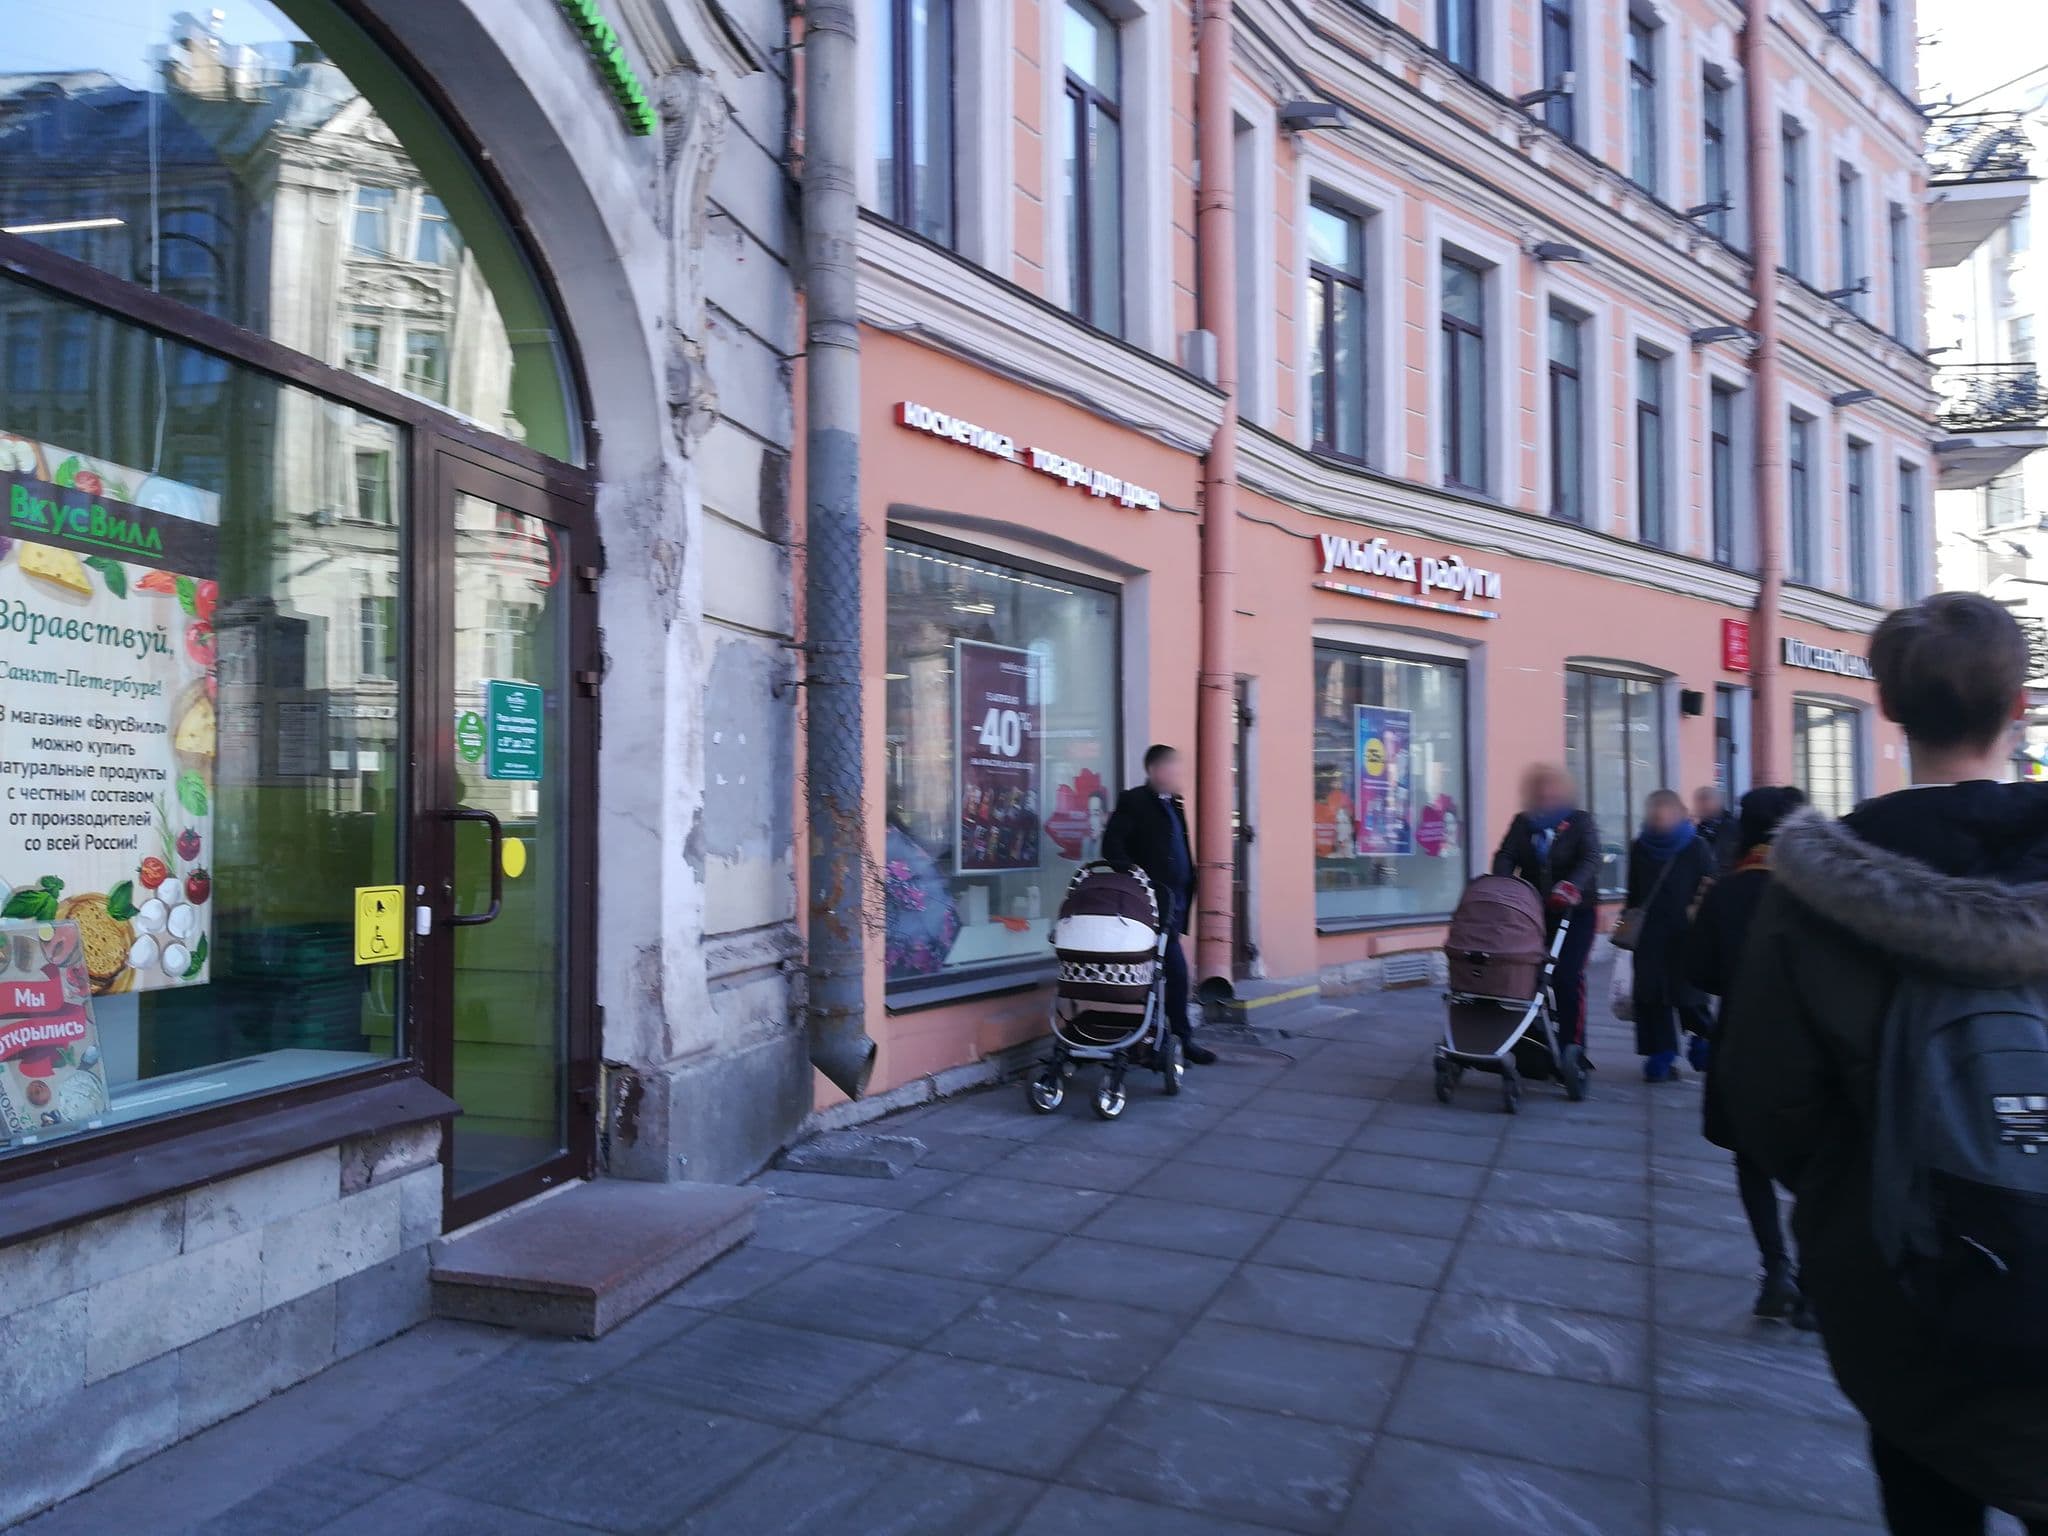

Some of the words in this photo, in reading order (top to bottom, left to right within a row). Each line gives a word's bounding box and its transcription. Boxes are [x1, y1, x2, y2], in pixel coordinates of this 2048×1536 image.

[10, 484, 163, 550] ВкусВилл
[1420, 555, 1501, 600] радуги
[11, 709, 82, 728] магазине
[86, 713, 167, 734] «ВкусВилл»
[32, 737, 83, 752] можно
[88, 741, 136, 757] купить
[99, 765, 166, 782] продукты
[7, 787, 15, 800] с
[20, 786, 86, 801] честным
[91, 788, 154, 803] составом
[9, 812, 27, 825] от
[32, 811, 151, 830] производителей
[24, 838, 42, 851] со
[47, 834, 80, 851] всей
[85, 833, 138, 851] России!
[15, 988, 46, 1008] Мы
